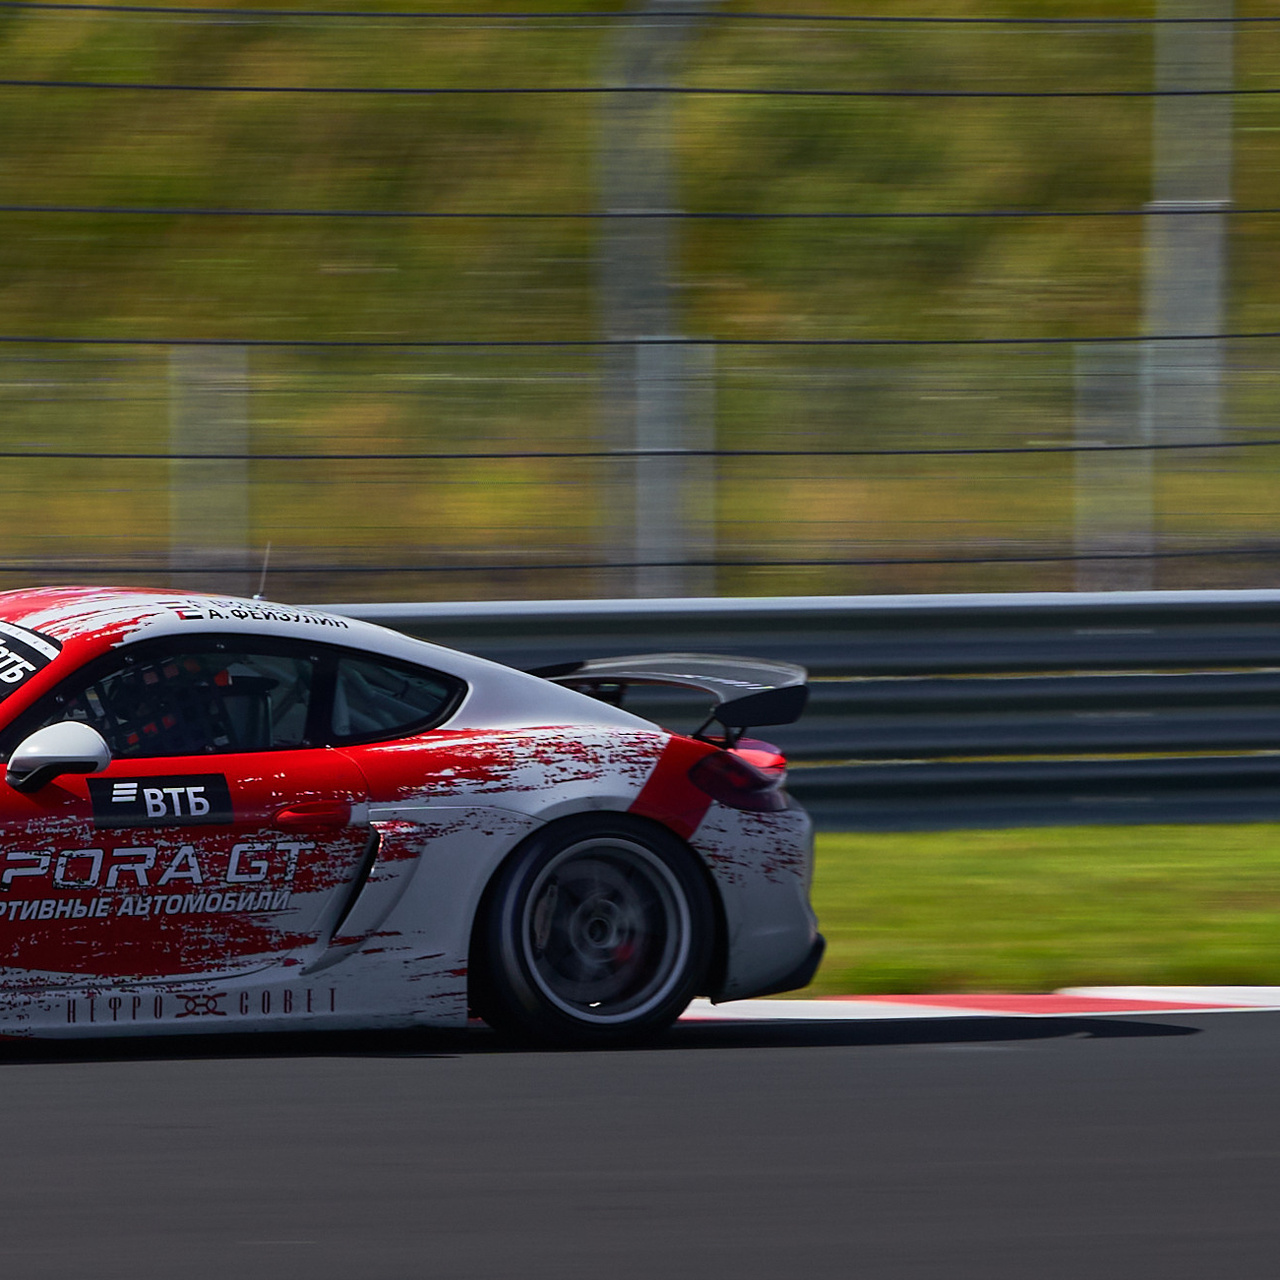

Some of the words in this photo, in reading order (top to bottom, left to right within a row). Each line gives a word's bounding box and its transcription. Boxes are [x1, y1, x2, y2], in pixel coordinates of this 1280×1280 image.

[143, 786, 210, 818] ВТБ
[226, 841, 317, 884] GT
[116, 890, 293, 917] АВТОМОБИЛИ
[239, 987, 338, 1015] СОВЕТ
